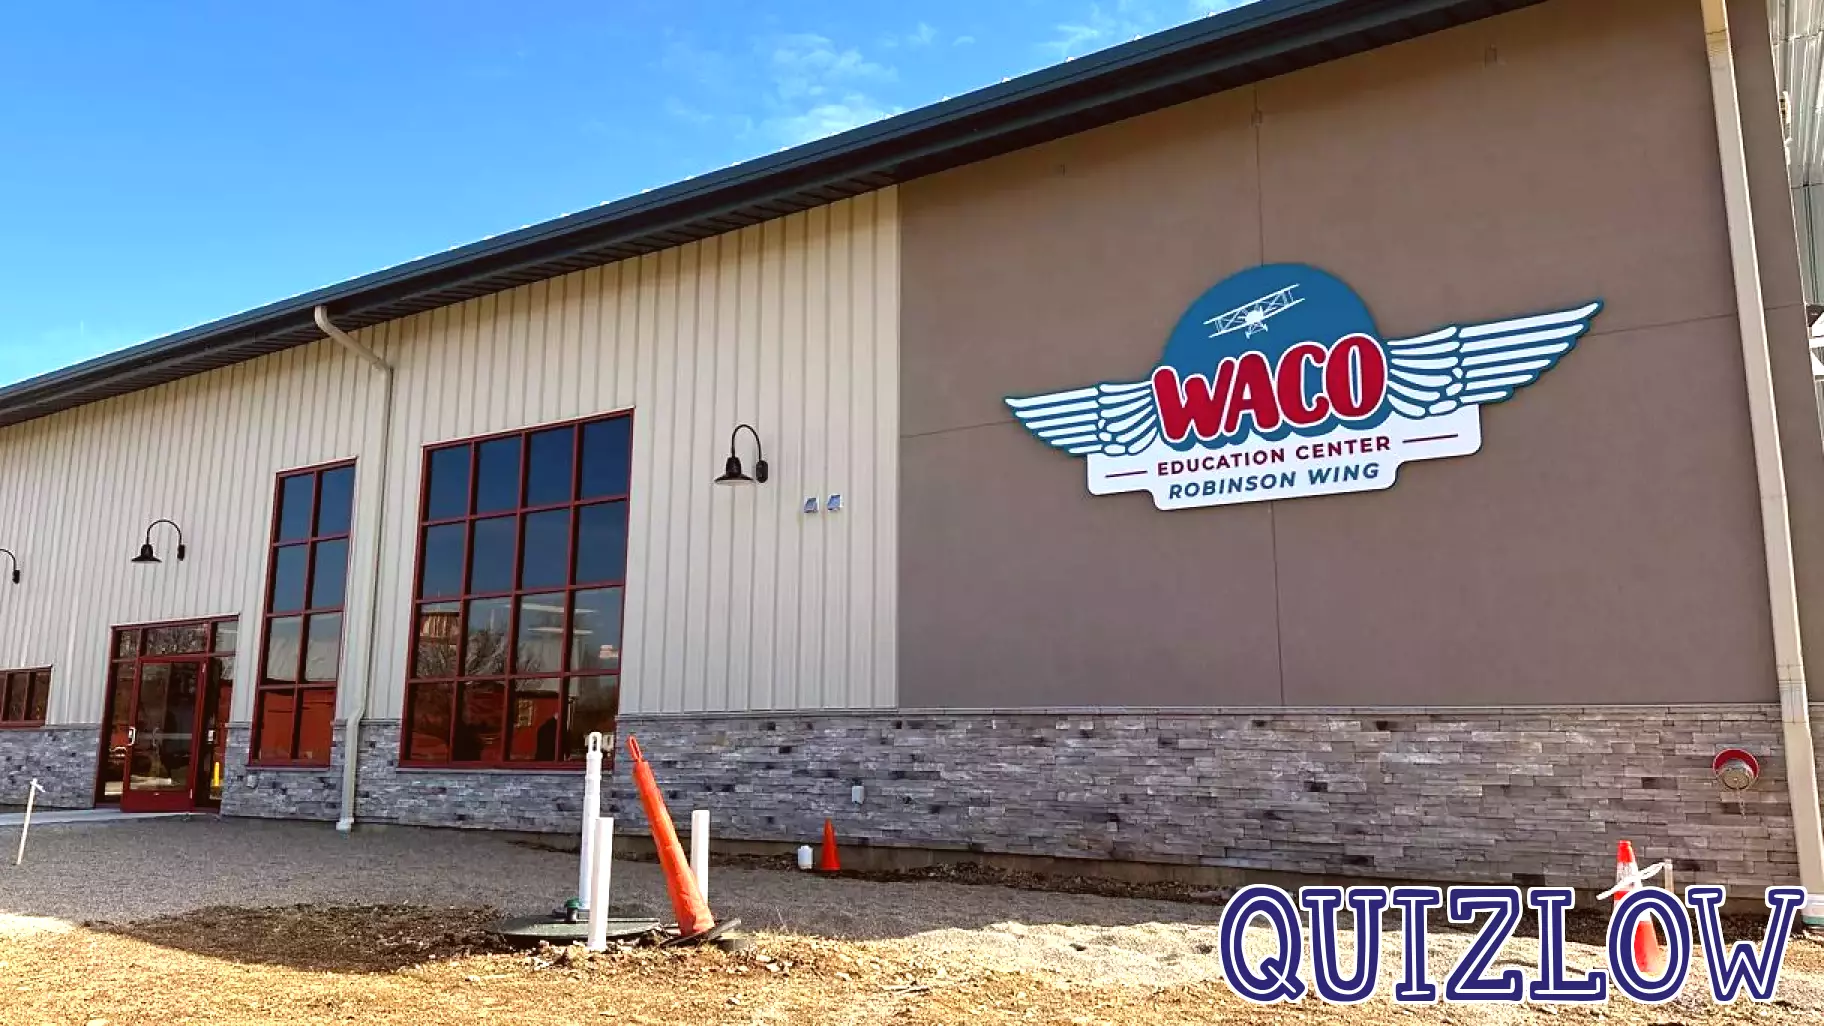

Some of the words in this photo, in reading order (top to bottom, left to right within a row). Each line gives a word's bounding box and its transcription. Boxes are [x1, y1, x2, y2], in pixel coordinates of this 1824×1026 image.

[1152, 333, 1388, 442] WACO
[1158, 449, 1285, 475] EDUCATION
[1296, 437, 1390, 460] CENTER
[1169, 472, 1296, 499] ROBINSON
[1309, 463, 1379, 485] WING
